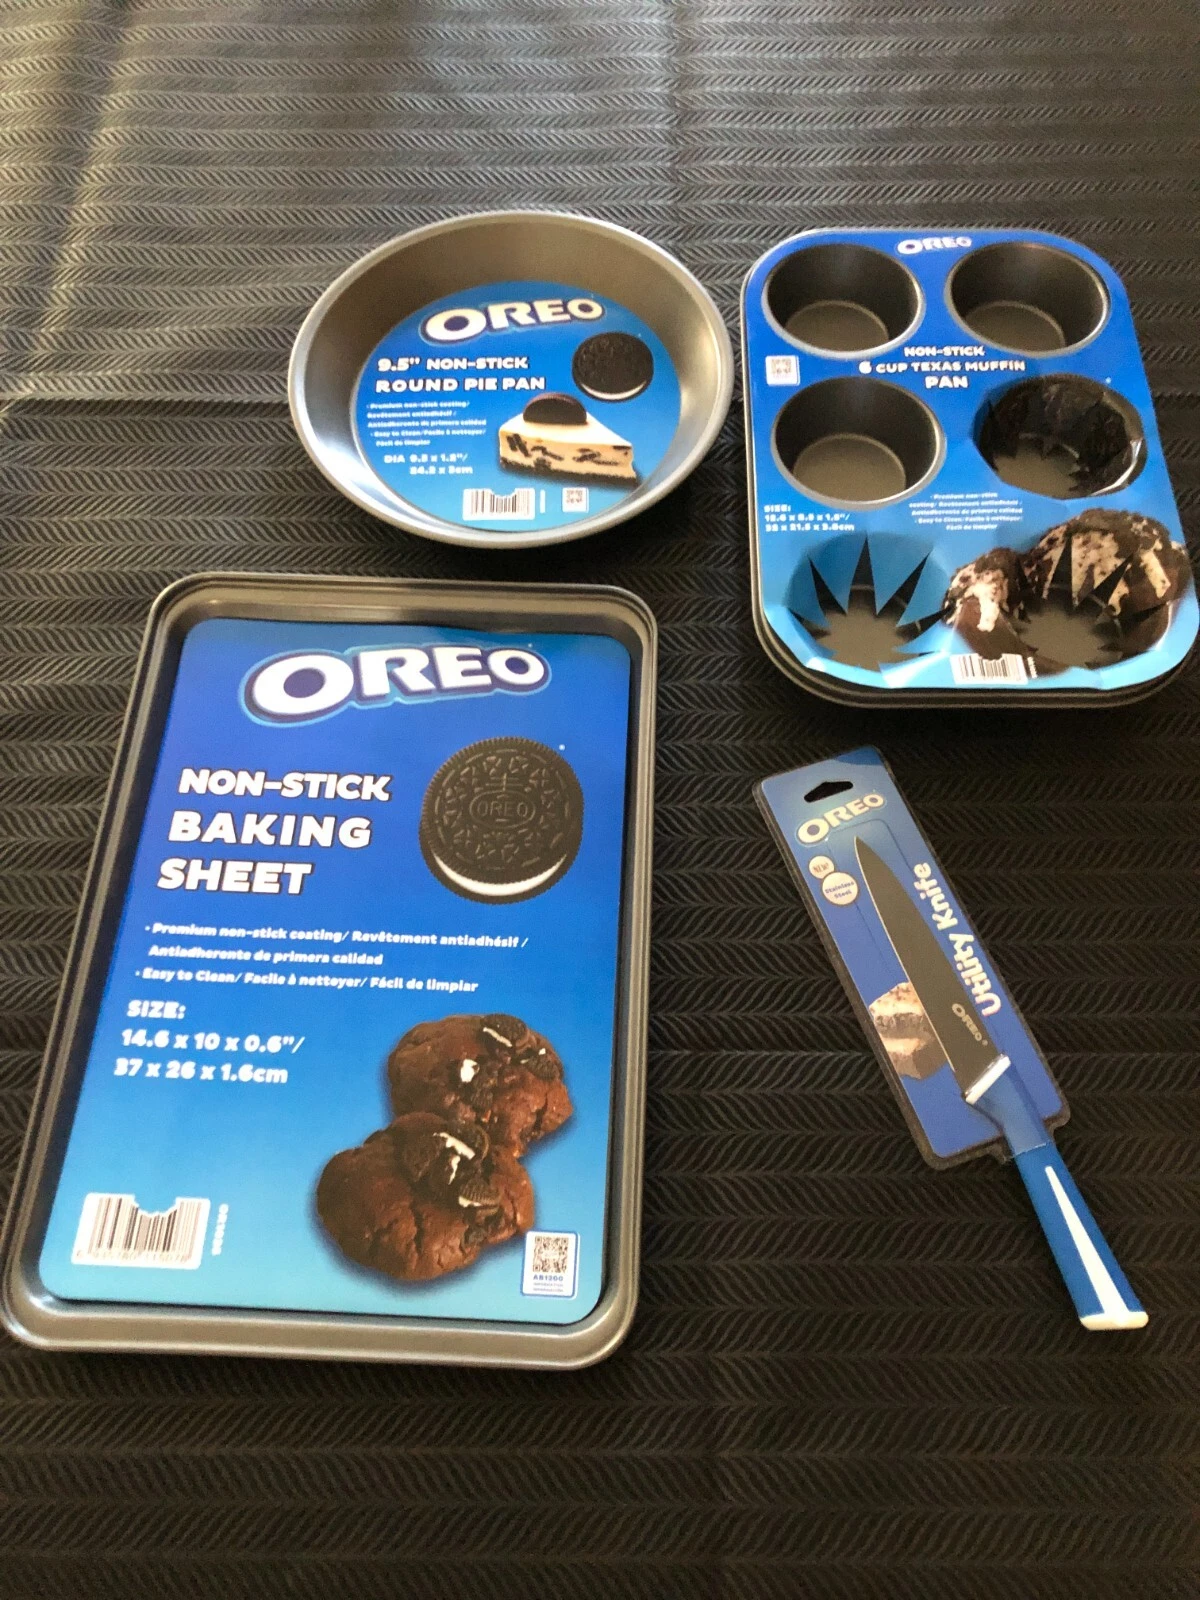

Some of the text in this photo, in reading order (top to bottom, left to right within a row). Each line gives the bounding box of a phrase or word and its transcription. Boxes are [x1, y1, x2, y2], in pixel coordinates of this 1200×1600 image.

[898, 237, 972, 254] OREO
[424, 298, 604, 342] OREO
[904, 345, 985, 357] NON-STICK
[377, 357, 529, 372] 9.5" NON-STICK
[859, 360, 1026, 375] 6 CUP TEXAS MUFFIN
[375, 377, 545, 393] ROUND PIE PAN
[925, 375, 969, 389] PAN
[384, 454, 406, 463] DIA
[252, 646, 545, 716] OREO
[178, 767, 392, 801] NON-STICK
[477, 800, 529, 817] OREO
[797, 793, 884, 844] OREO
[168, 809, 373, 849] BAKING
[156, 856, 313, 895] SHEET
[152, 922, 217, 937] Premium
[219, 926, 288, 940] non-stick
[289, 928, 350, 943] coating/
[352, 930, 438, 944] Revêtement
[913, 862, 1002, 1017] Utility Knife
[148, 945, 384, 966] Antiadherente de primera calidad
[142, 967, 175, 982] Easy
[177, 969, 193, 981] to
[195, 970, 243, 984] Clean/
[244, 971, 286, 985] Facile
[370, 976, 404, 990] Fácil
[406, 978, 424, 990] de
[426, 979, 478, 993] limpiar
[127, 1000, 187, 1020] SIZE:
[951, 1003, 983, 1042] OREO
[122, 1028, 170, 1048] 14.6
[173, 1034, 190, 1049] x
[194, 1032, 221, 1051] 10
[224, 1036, 241, 1052] x
[113, 1057, 289, 1084] 37 x 26 x 1.6cm
